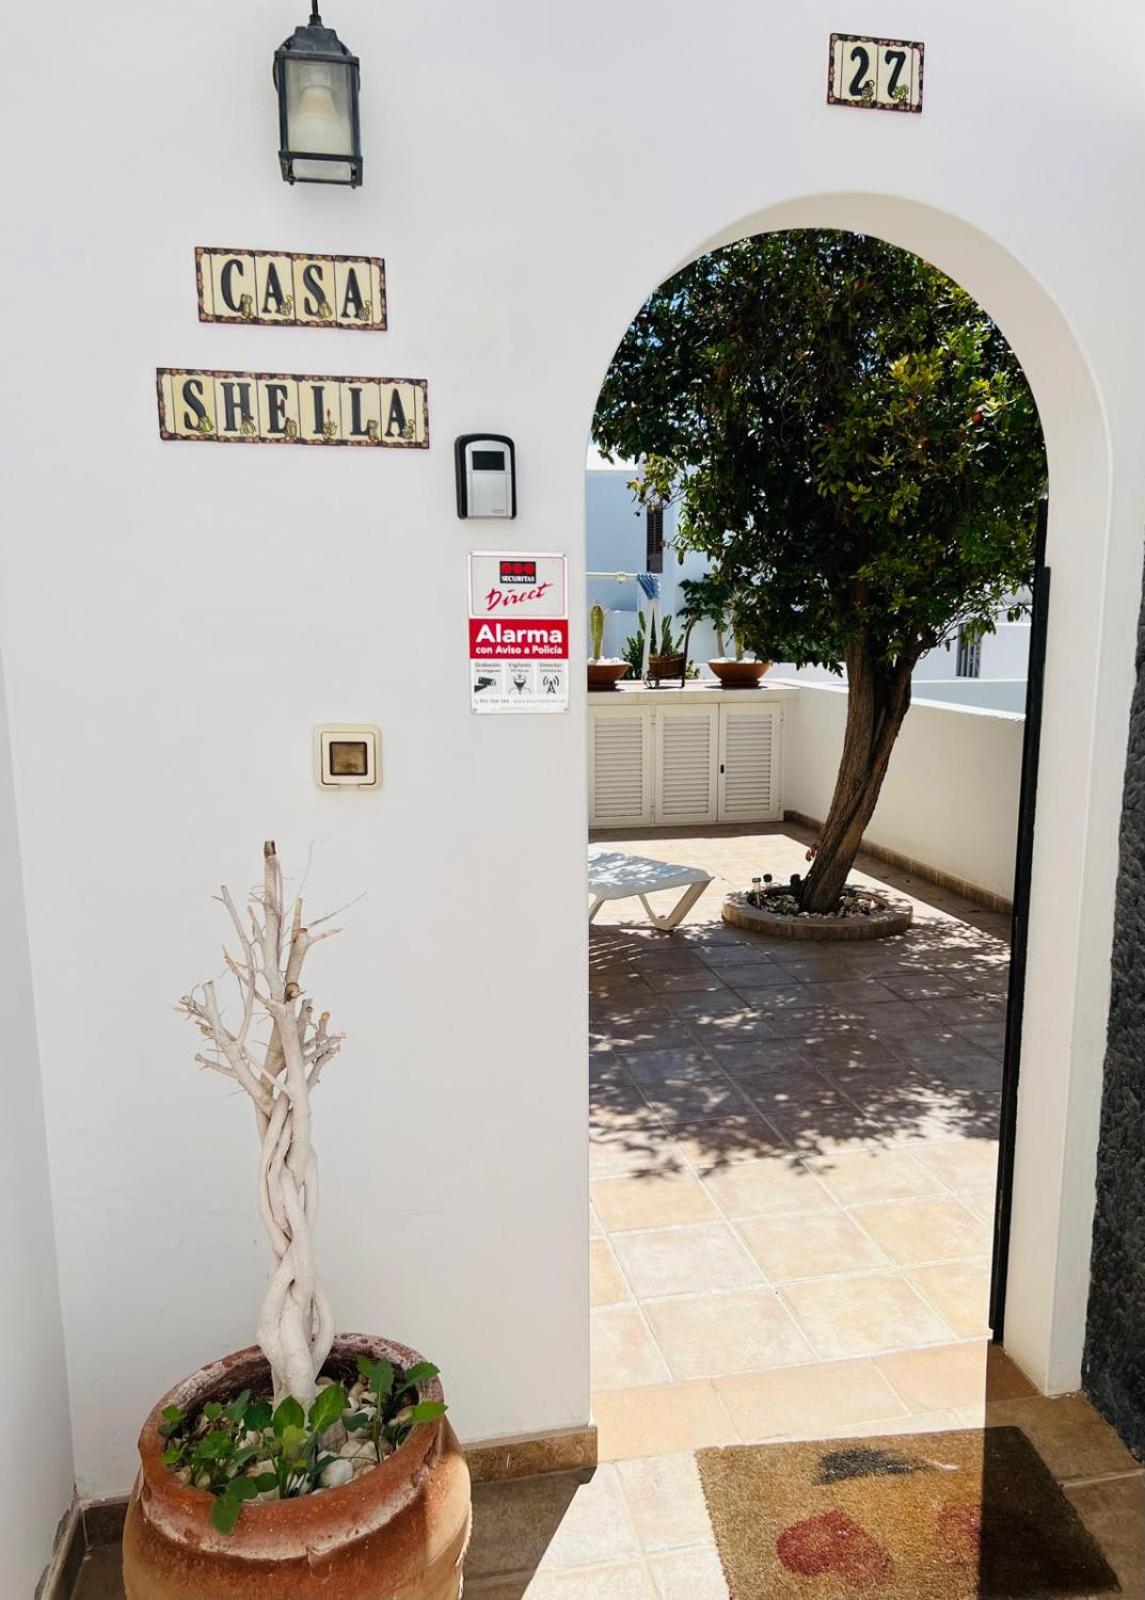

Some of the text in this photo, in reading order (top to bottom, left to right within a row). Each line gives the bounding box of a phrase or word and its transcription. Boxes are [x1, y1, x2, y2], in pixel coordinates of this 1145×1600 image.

[849, 46, 906, 99] 27
[220, 258, 366, 320] CASA
[182, 378, 411, 438] SHEILA
[485, 583, 554, 611] Direct
[475, 623, 563, 643] Alarma
[475, 646, 493, 654] con
[495, 645, 521, 655] Aviso
